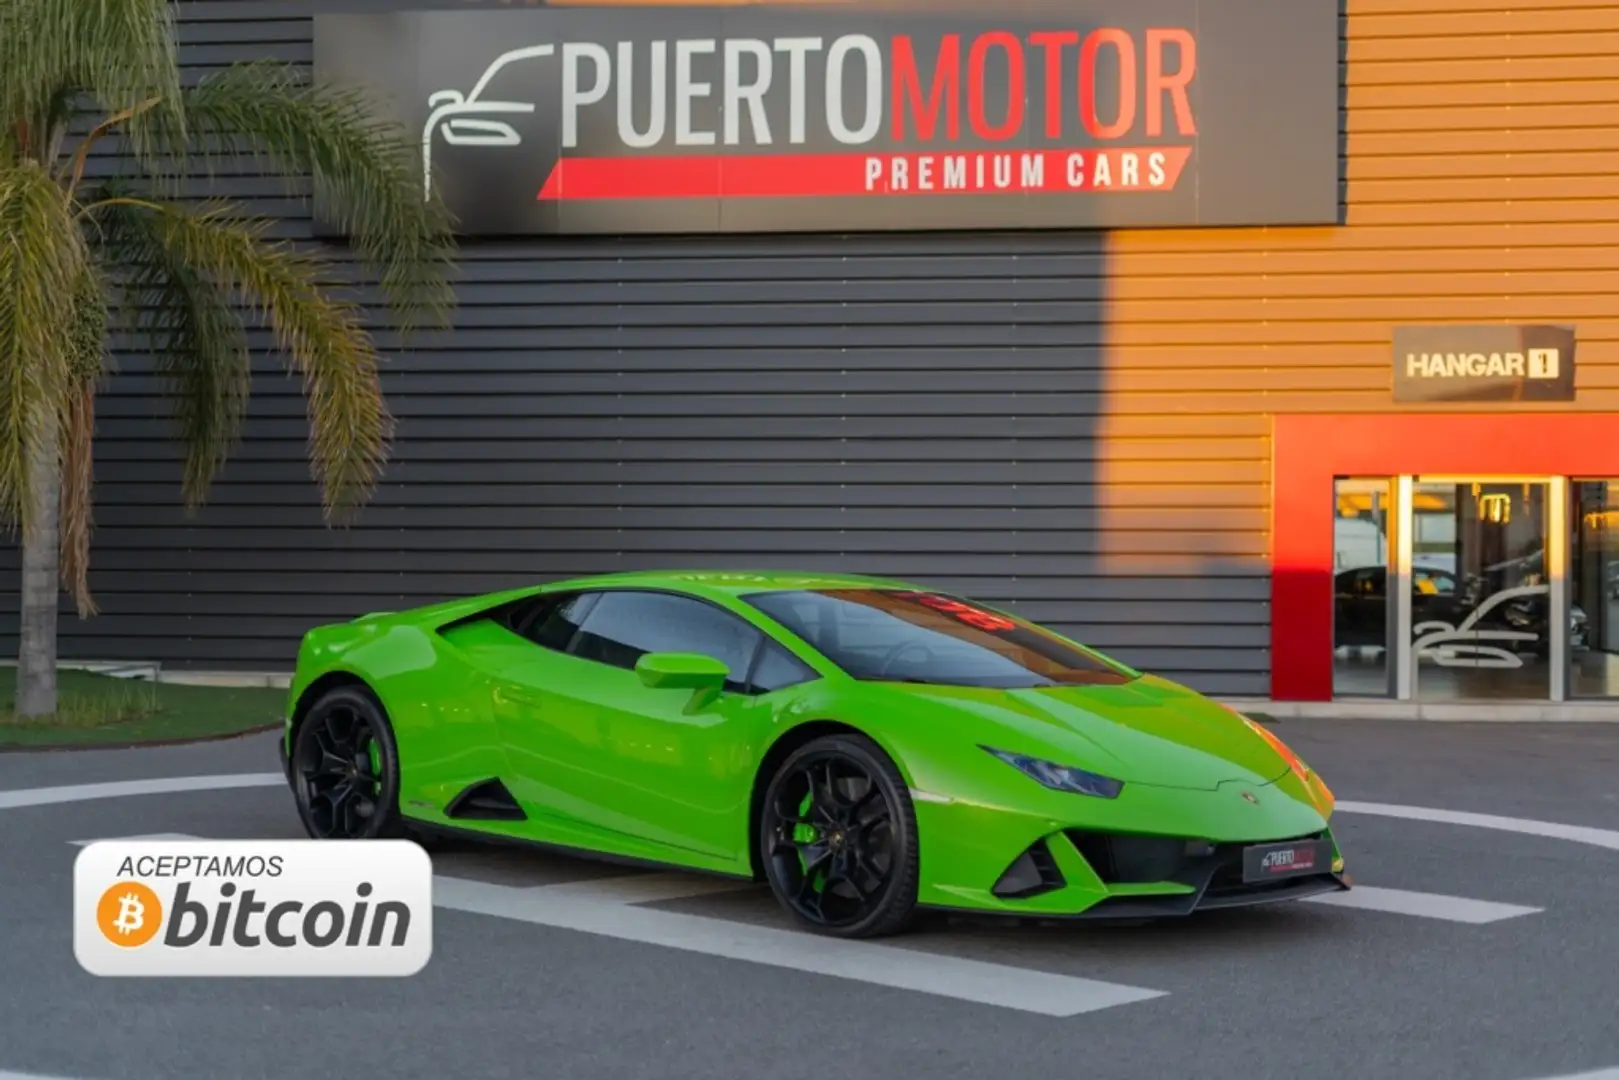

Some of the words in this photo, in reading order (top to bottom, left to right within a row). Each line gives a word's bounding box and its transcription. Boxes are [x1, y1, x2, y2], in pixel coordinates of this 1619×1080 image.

[865, 154, 1043, 190] PREMIUM
[1067, 152, 1165, 187] CARS
[1406, 353, 1525, 377] HANGAR
